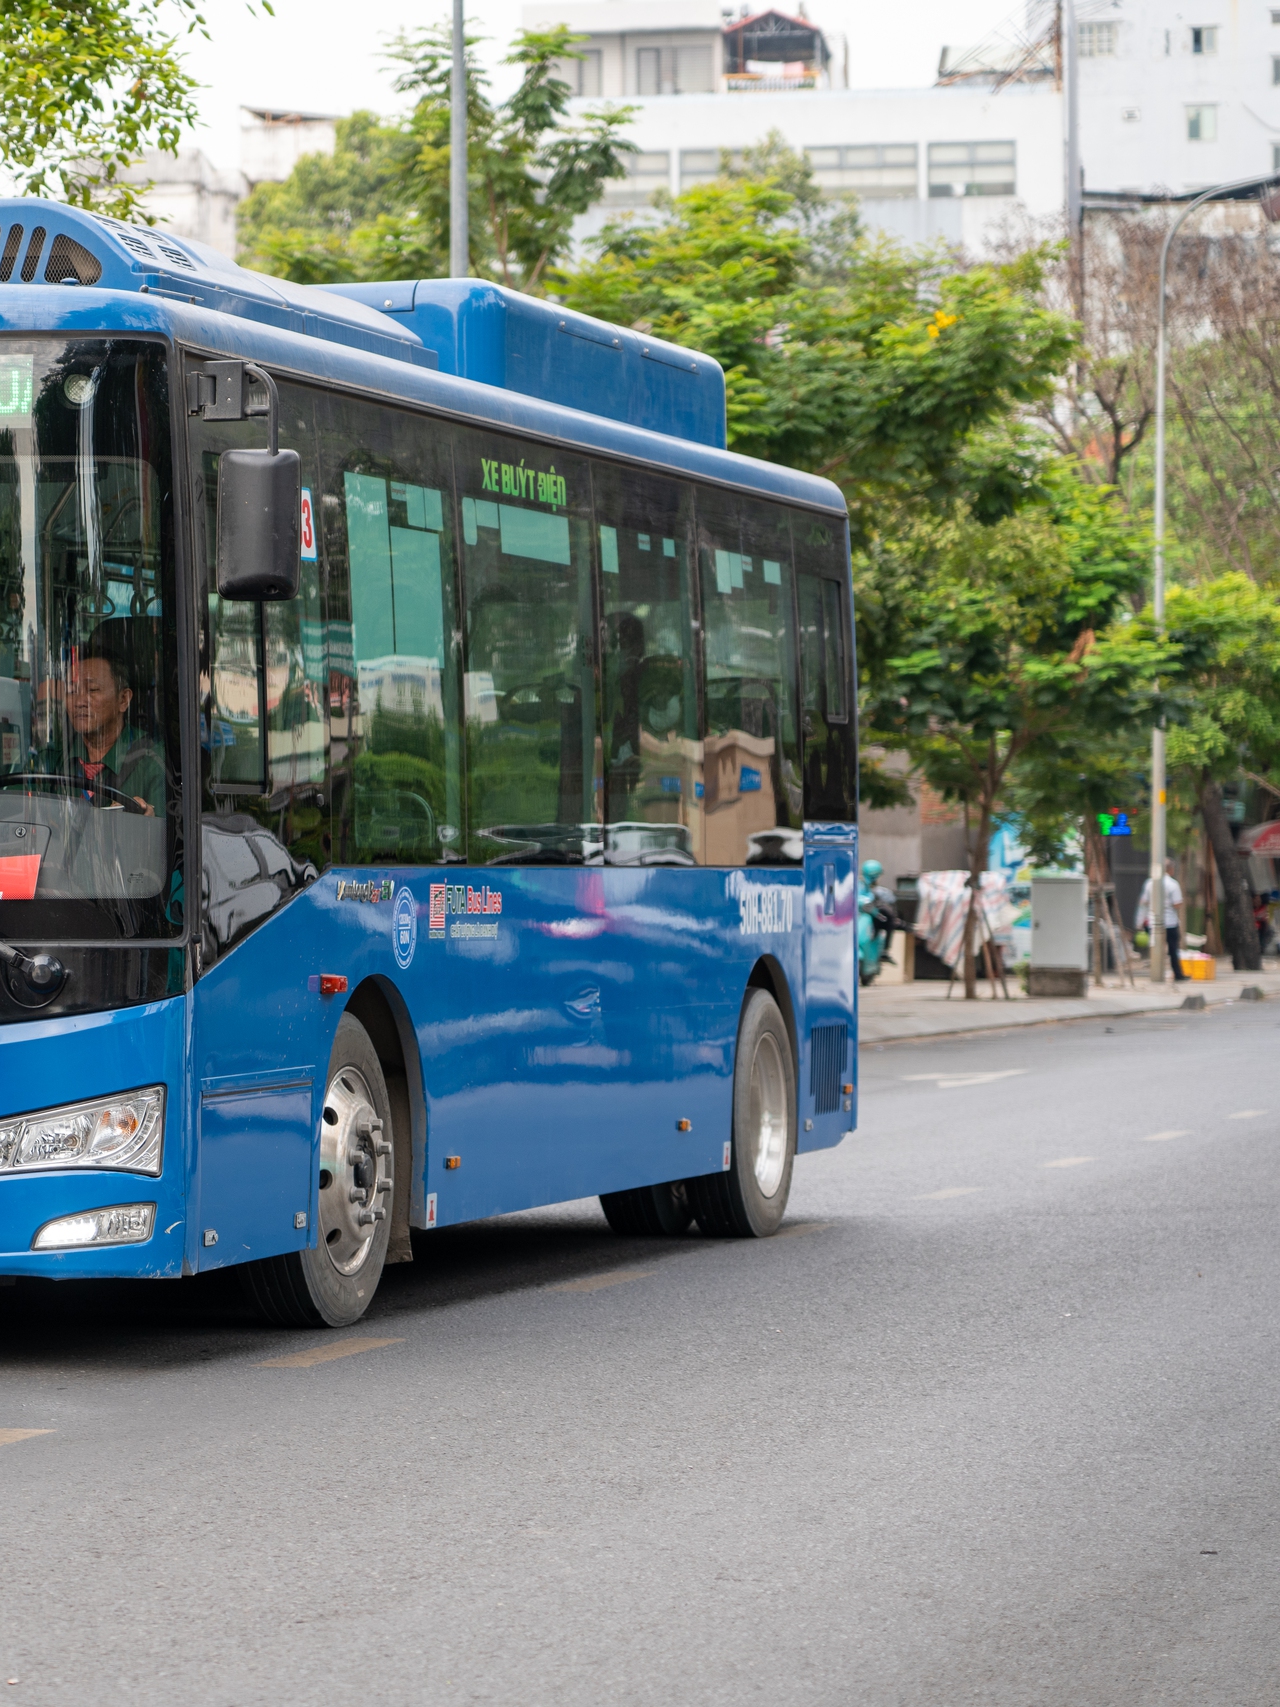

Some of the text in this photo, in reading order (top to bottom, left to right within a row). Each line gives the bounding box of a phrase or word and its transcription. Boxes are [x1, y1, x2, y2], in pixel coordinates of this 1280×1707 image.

[481, 457, 500, 493] XE
[501, 458, 536, 501] BUÝT
[445, 885, 466, 914] FUTA
[467, 885, 481, 914] Bus
[481, 885, 502, 914] Lines
[740, 888, 793, 936] 50H-881.70
